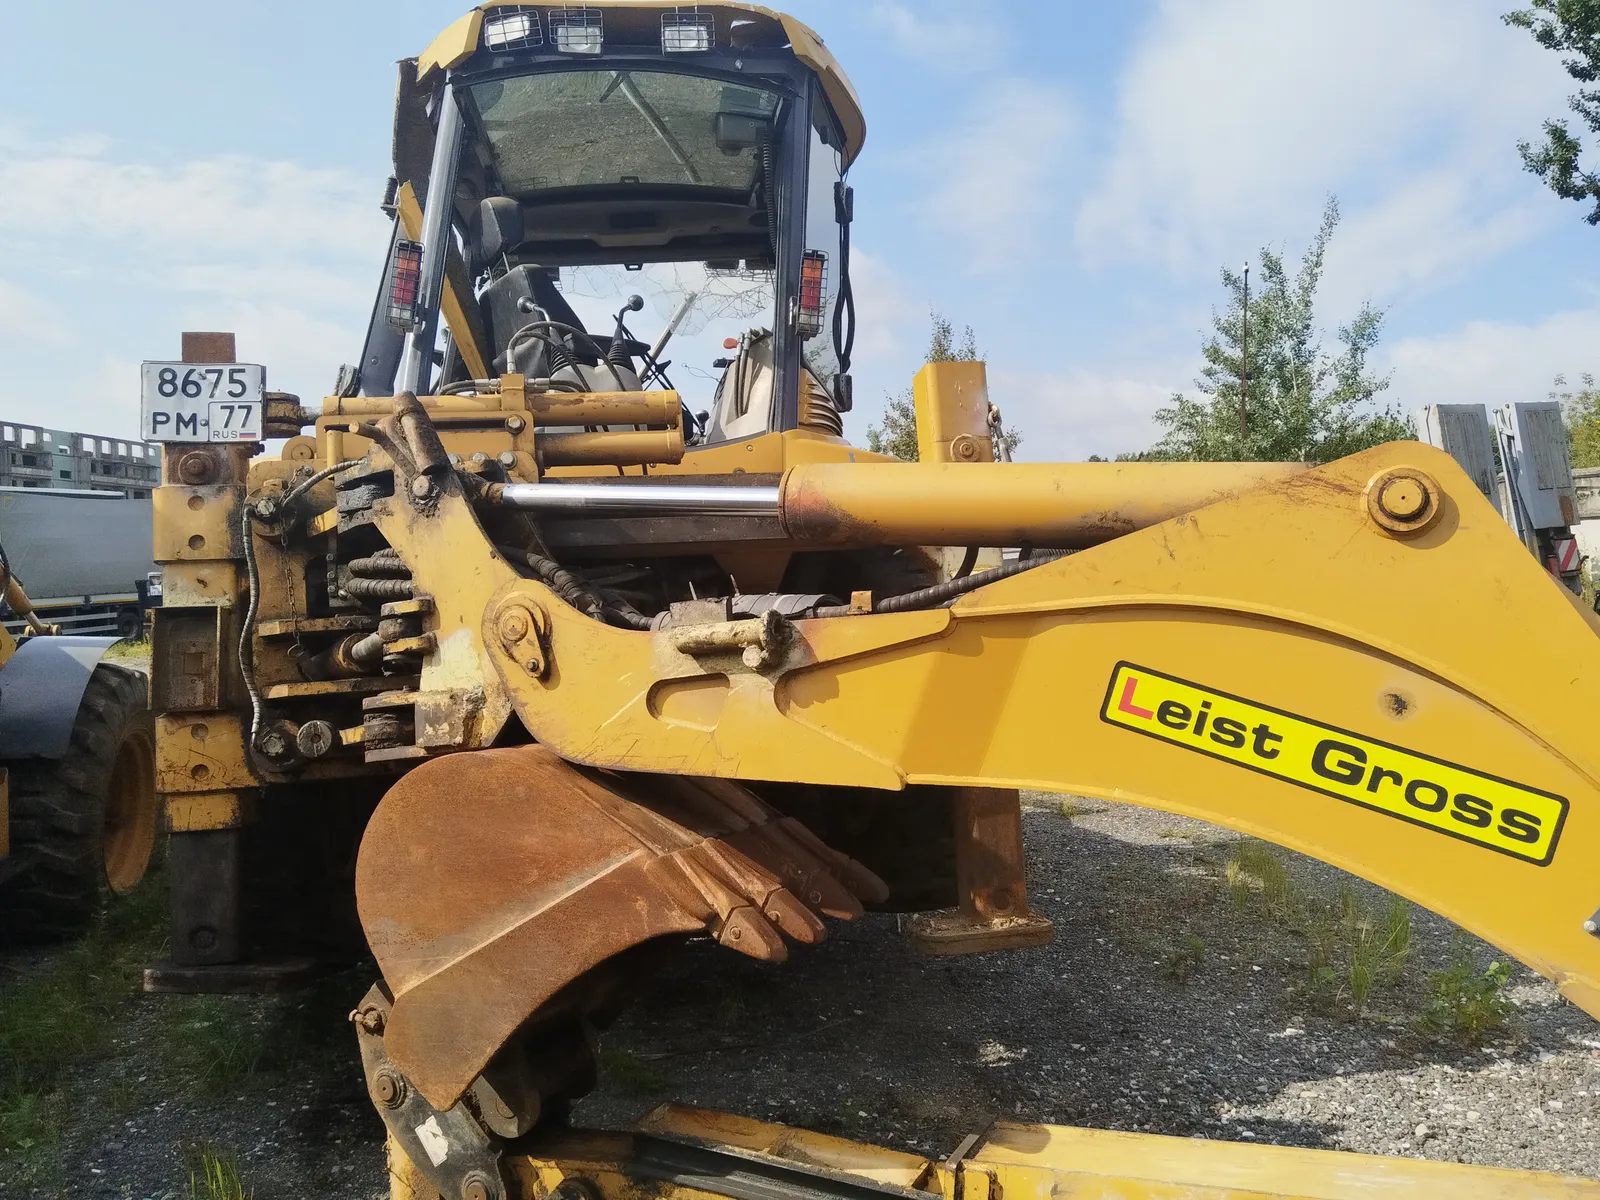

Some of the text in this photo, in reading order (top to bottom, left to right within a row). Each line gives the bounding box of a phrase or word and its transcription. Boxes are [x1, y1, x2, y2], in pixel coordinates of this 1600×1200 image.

[158, 367, 247, 398] 8675
[220, 405, 252, 428] 77
[212, 430, 238, 439] RUS
[1118, 676, 1542, 844] Leist Gross
